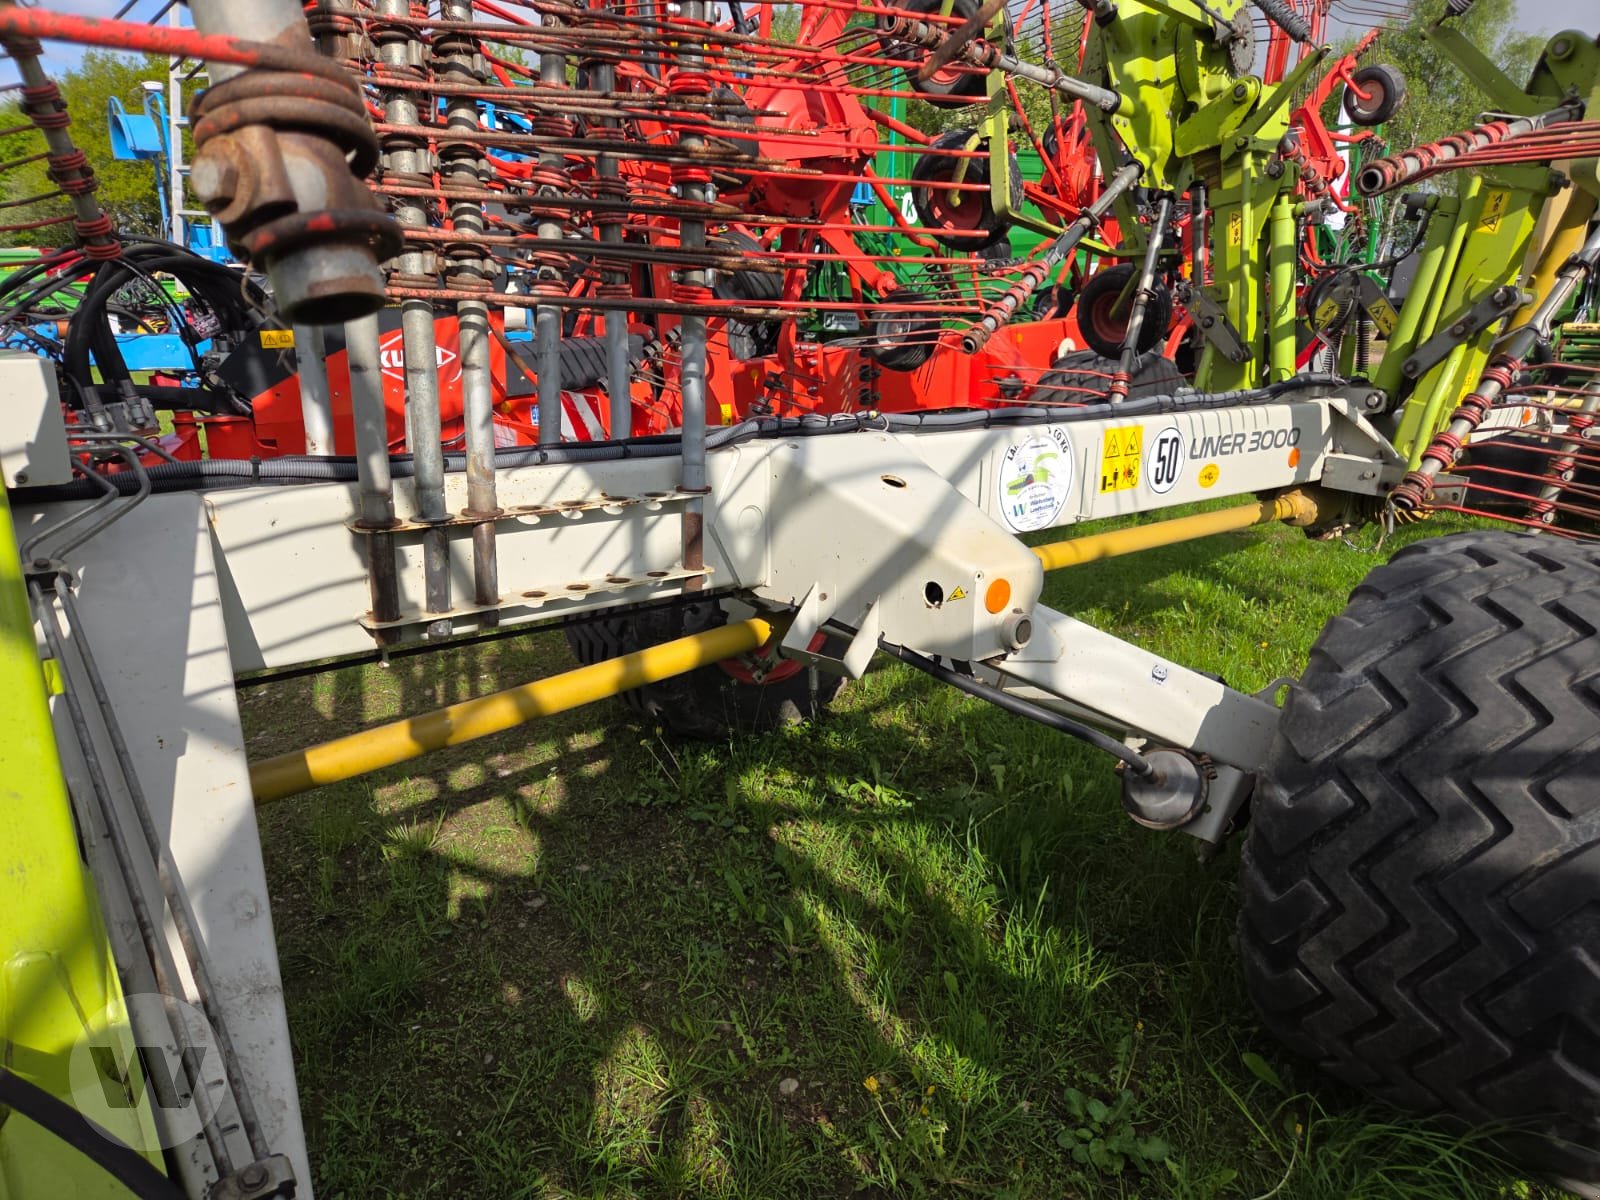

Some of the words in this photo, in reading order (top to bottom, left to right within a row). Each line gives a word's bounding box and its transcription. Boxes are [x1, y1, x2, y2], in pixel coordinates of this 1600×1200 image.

[1155, 437, 1180, 485] 50
[1190, 433, 1246, 459] LINER
[1248, 428, 1301, 452] 3000
